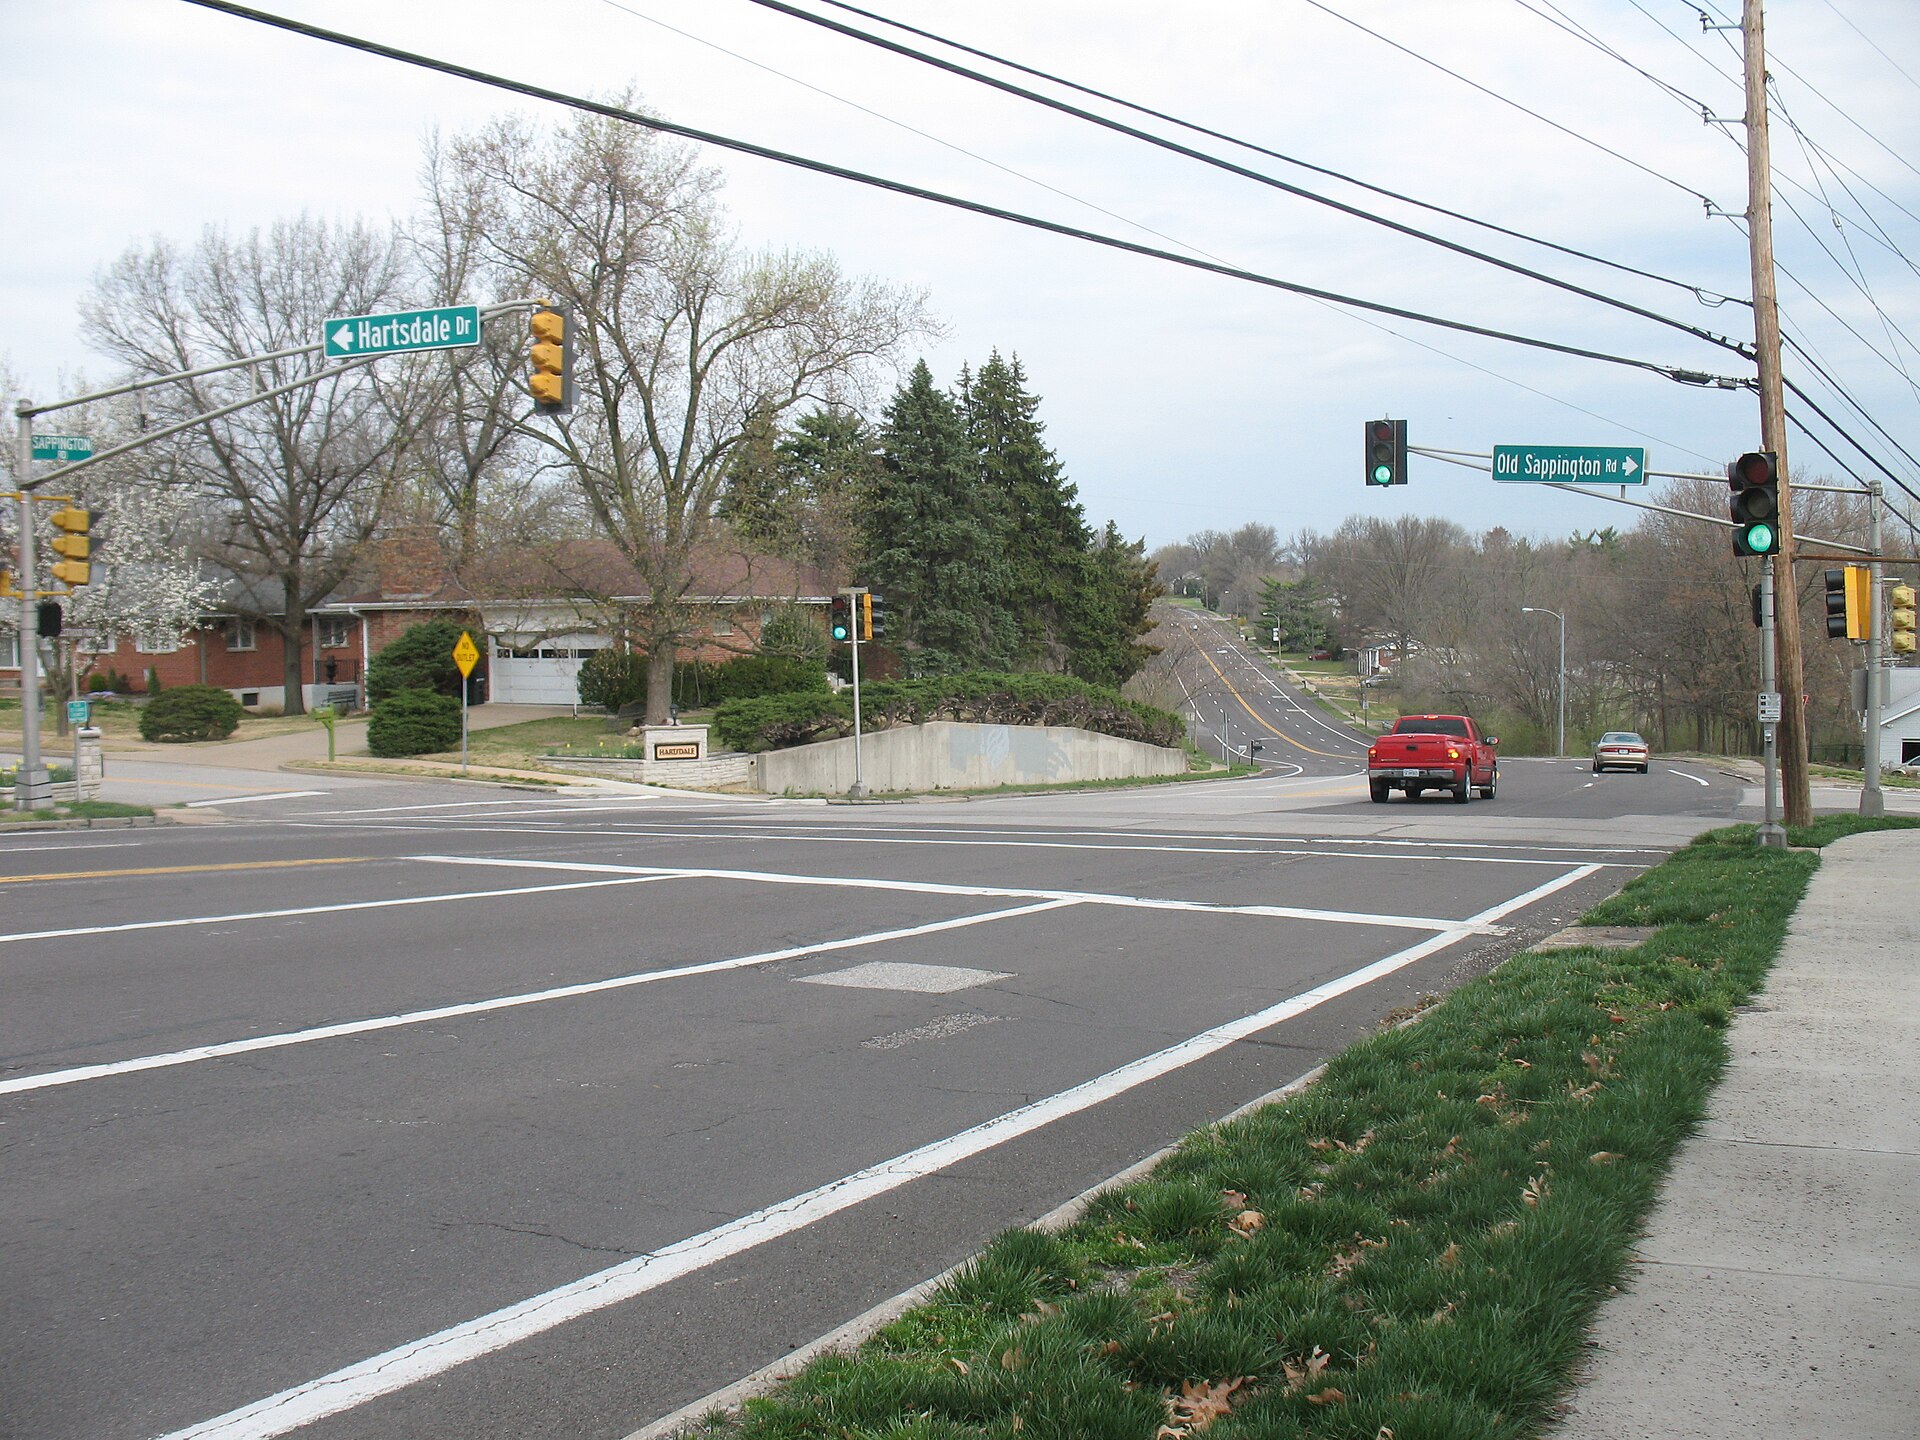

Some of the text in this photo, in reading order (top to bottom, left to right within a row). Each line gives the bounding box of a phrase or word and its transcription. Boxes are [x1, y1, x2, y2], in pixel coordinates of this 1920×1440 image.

[358, 314, 471, 349] Hartsdale Dr
[32, 436, 91, 450] SAPPINGTON
[1497, 453, 1617, 481] Old Sappington Rd
[659, 747, 696, 755] HARTSDALE
